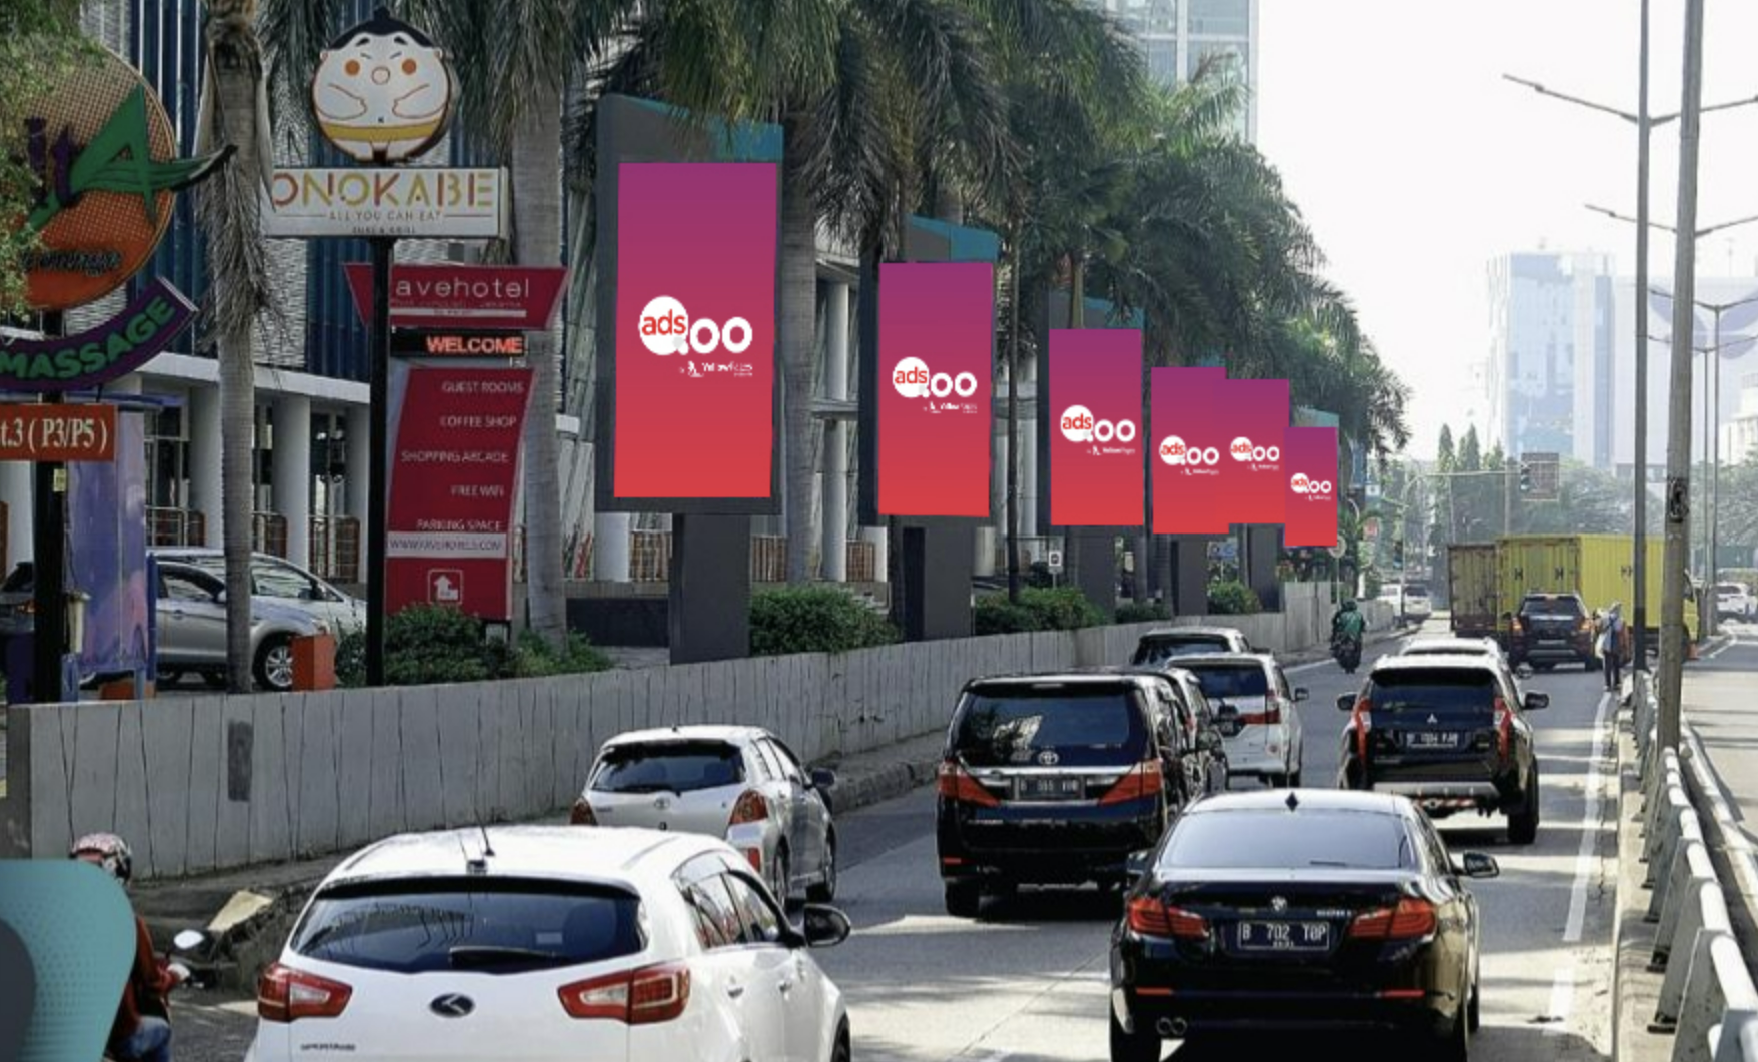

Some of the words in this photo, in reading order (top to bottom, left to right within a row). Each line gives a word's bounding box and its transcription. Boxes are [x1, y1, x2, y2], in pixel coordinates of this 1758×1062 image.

[396, 277, 529, 298] avehotel
[0, 296, 176, 379] MASSAGE
[426, 336, 524, 353] WELCOME
[1242, 923, 1251, 940] B
[1266, 923, 1290, 940] 702
